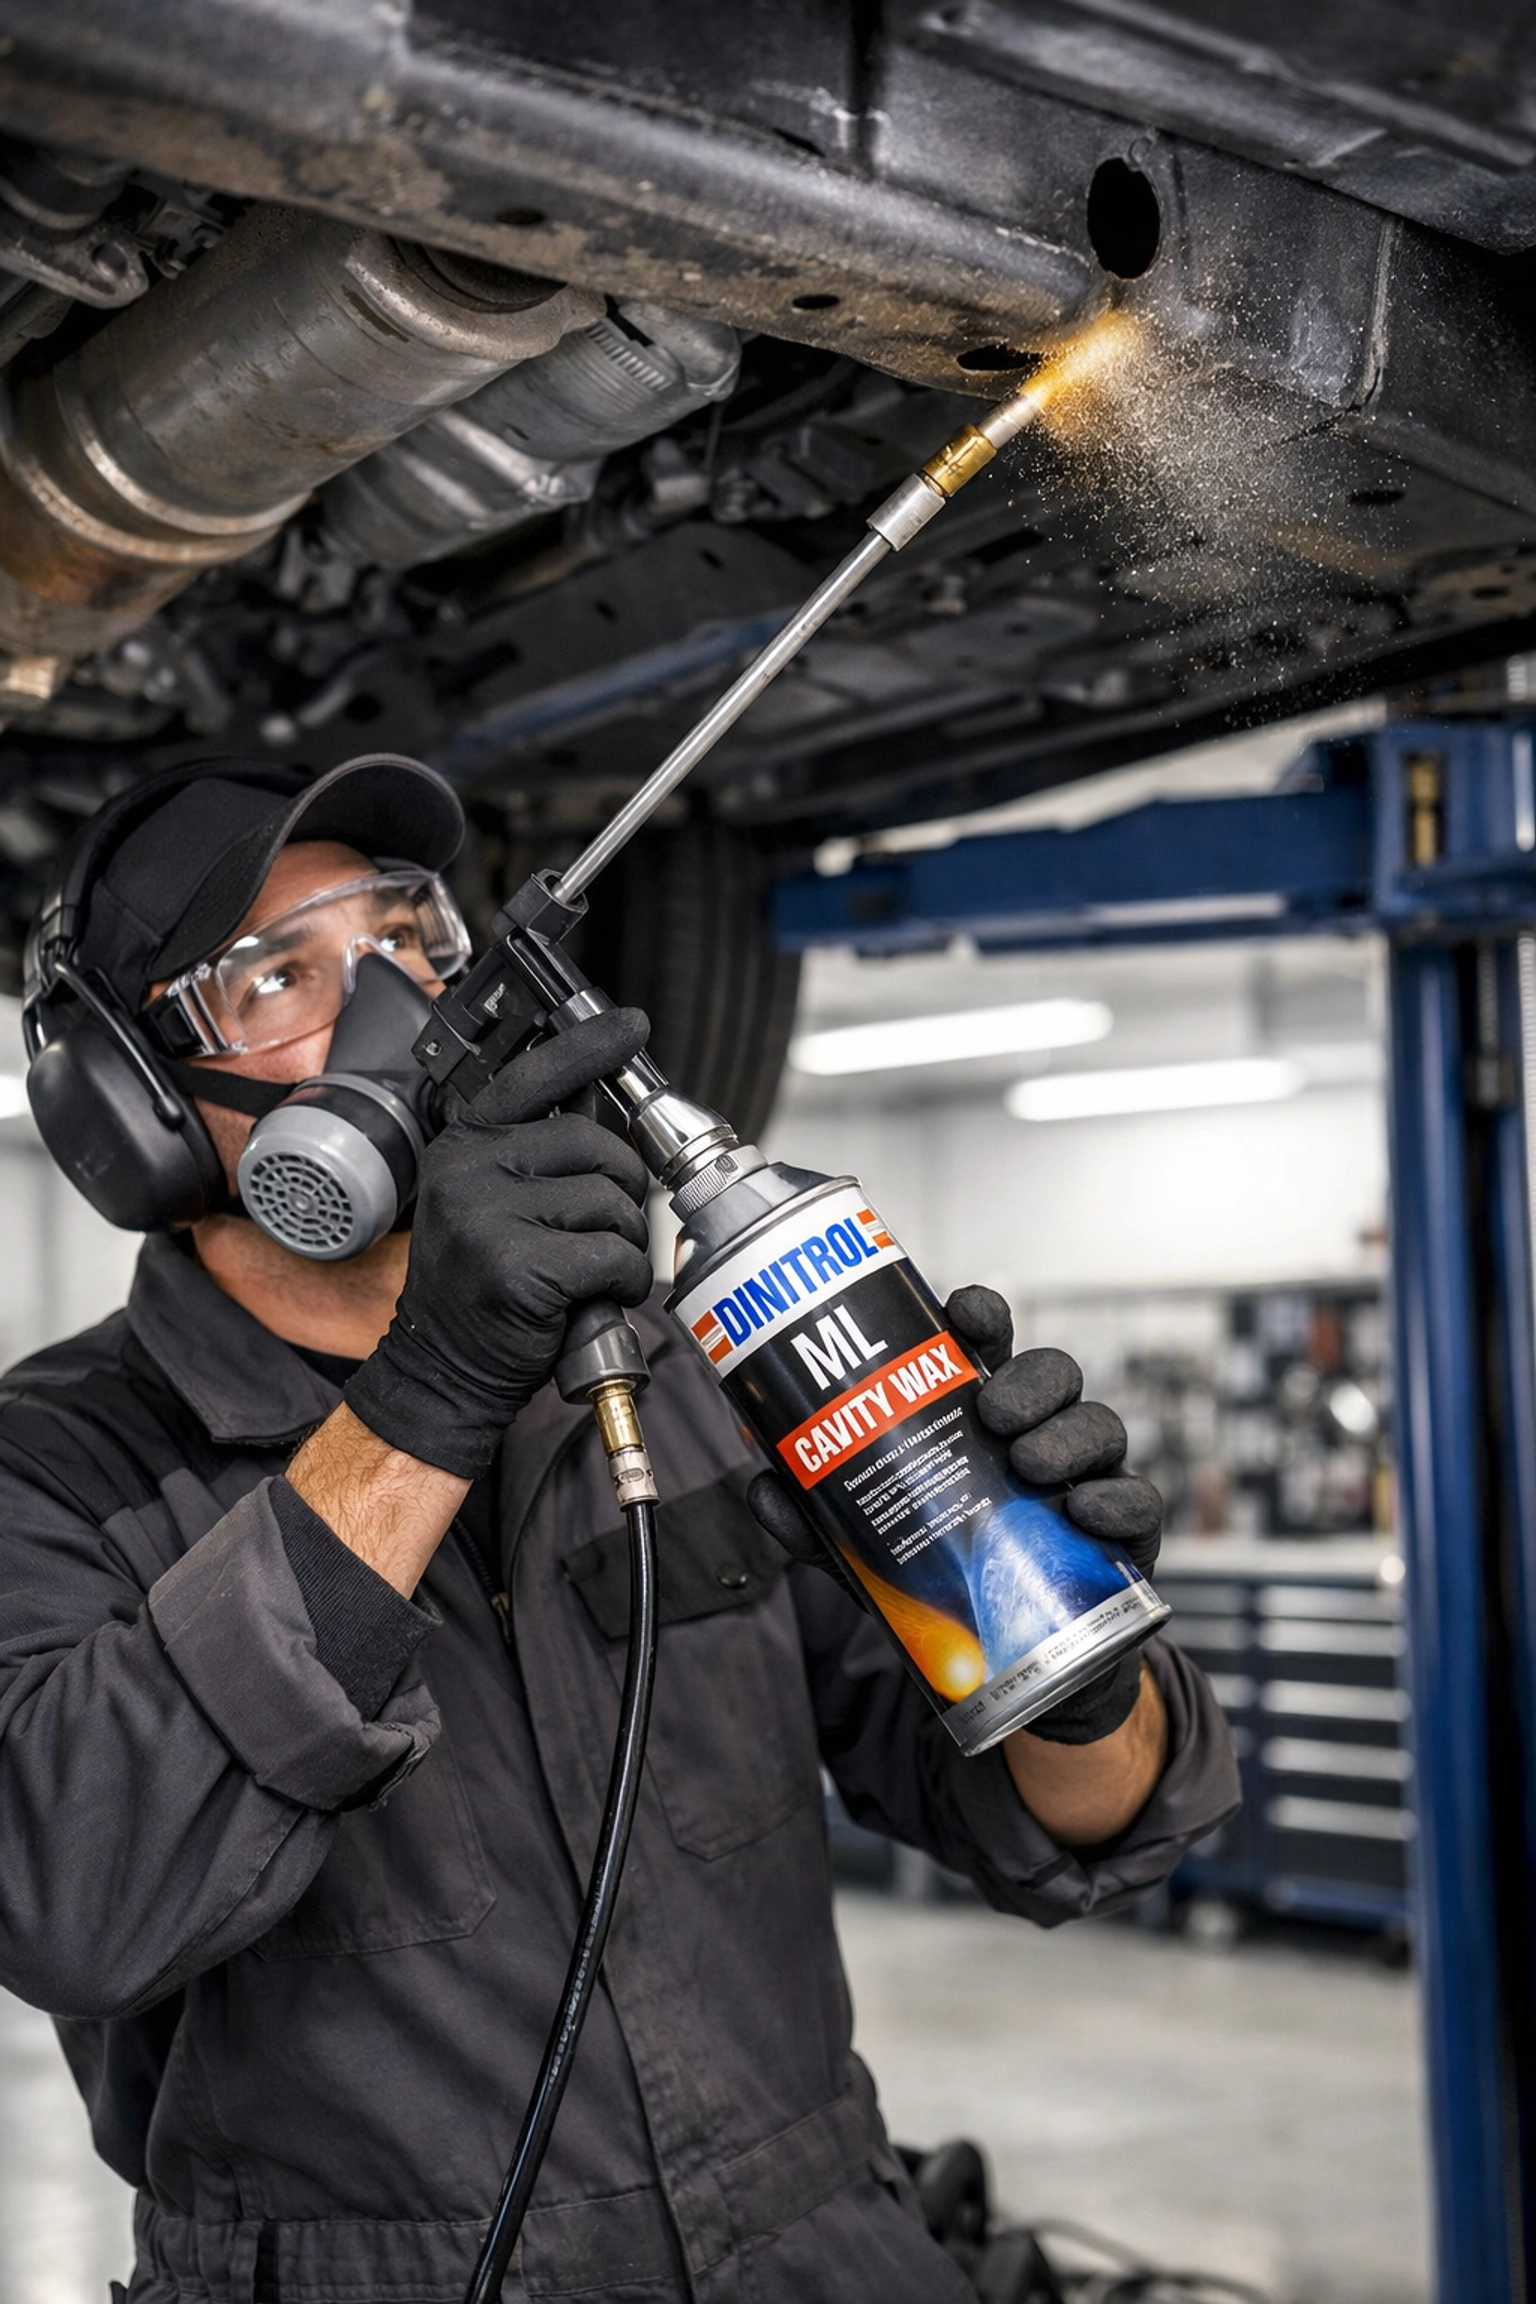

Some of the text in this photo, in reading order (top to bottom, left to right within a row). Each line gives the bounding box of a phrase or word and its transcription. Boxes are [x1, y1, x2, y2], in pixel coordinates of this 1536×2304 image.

[712, 1217, 879, 1347] DINITROL
[790, 1304, 889, 1391] ML
[794, 1381, 895, 1473] CAVITY
[888, 1343, 963, 1404] WAX
